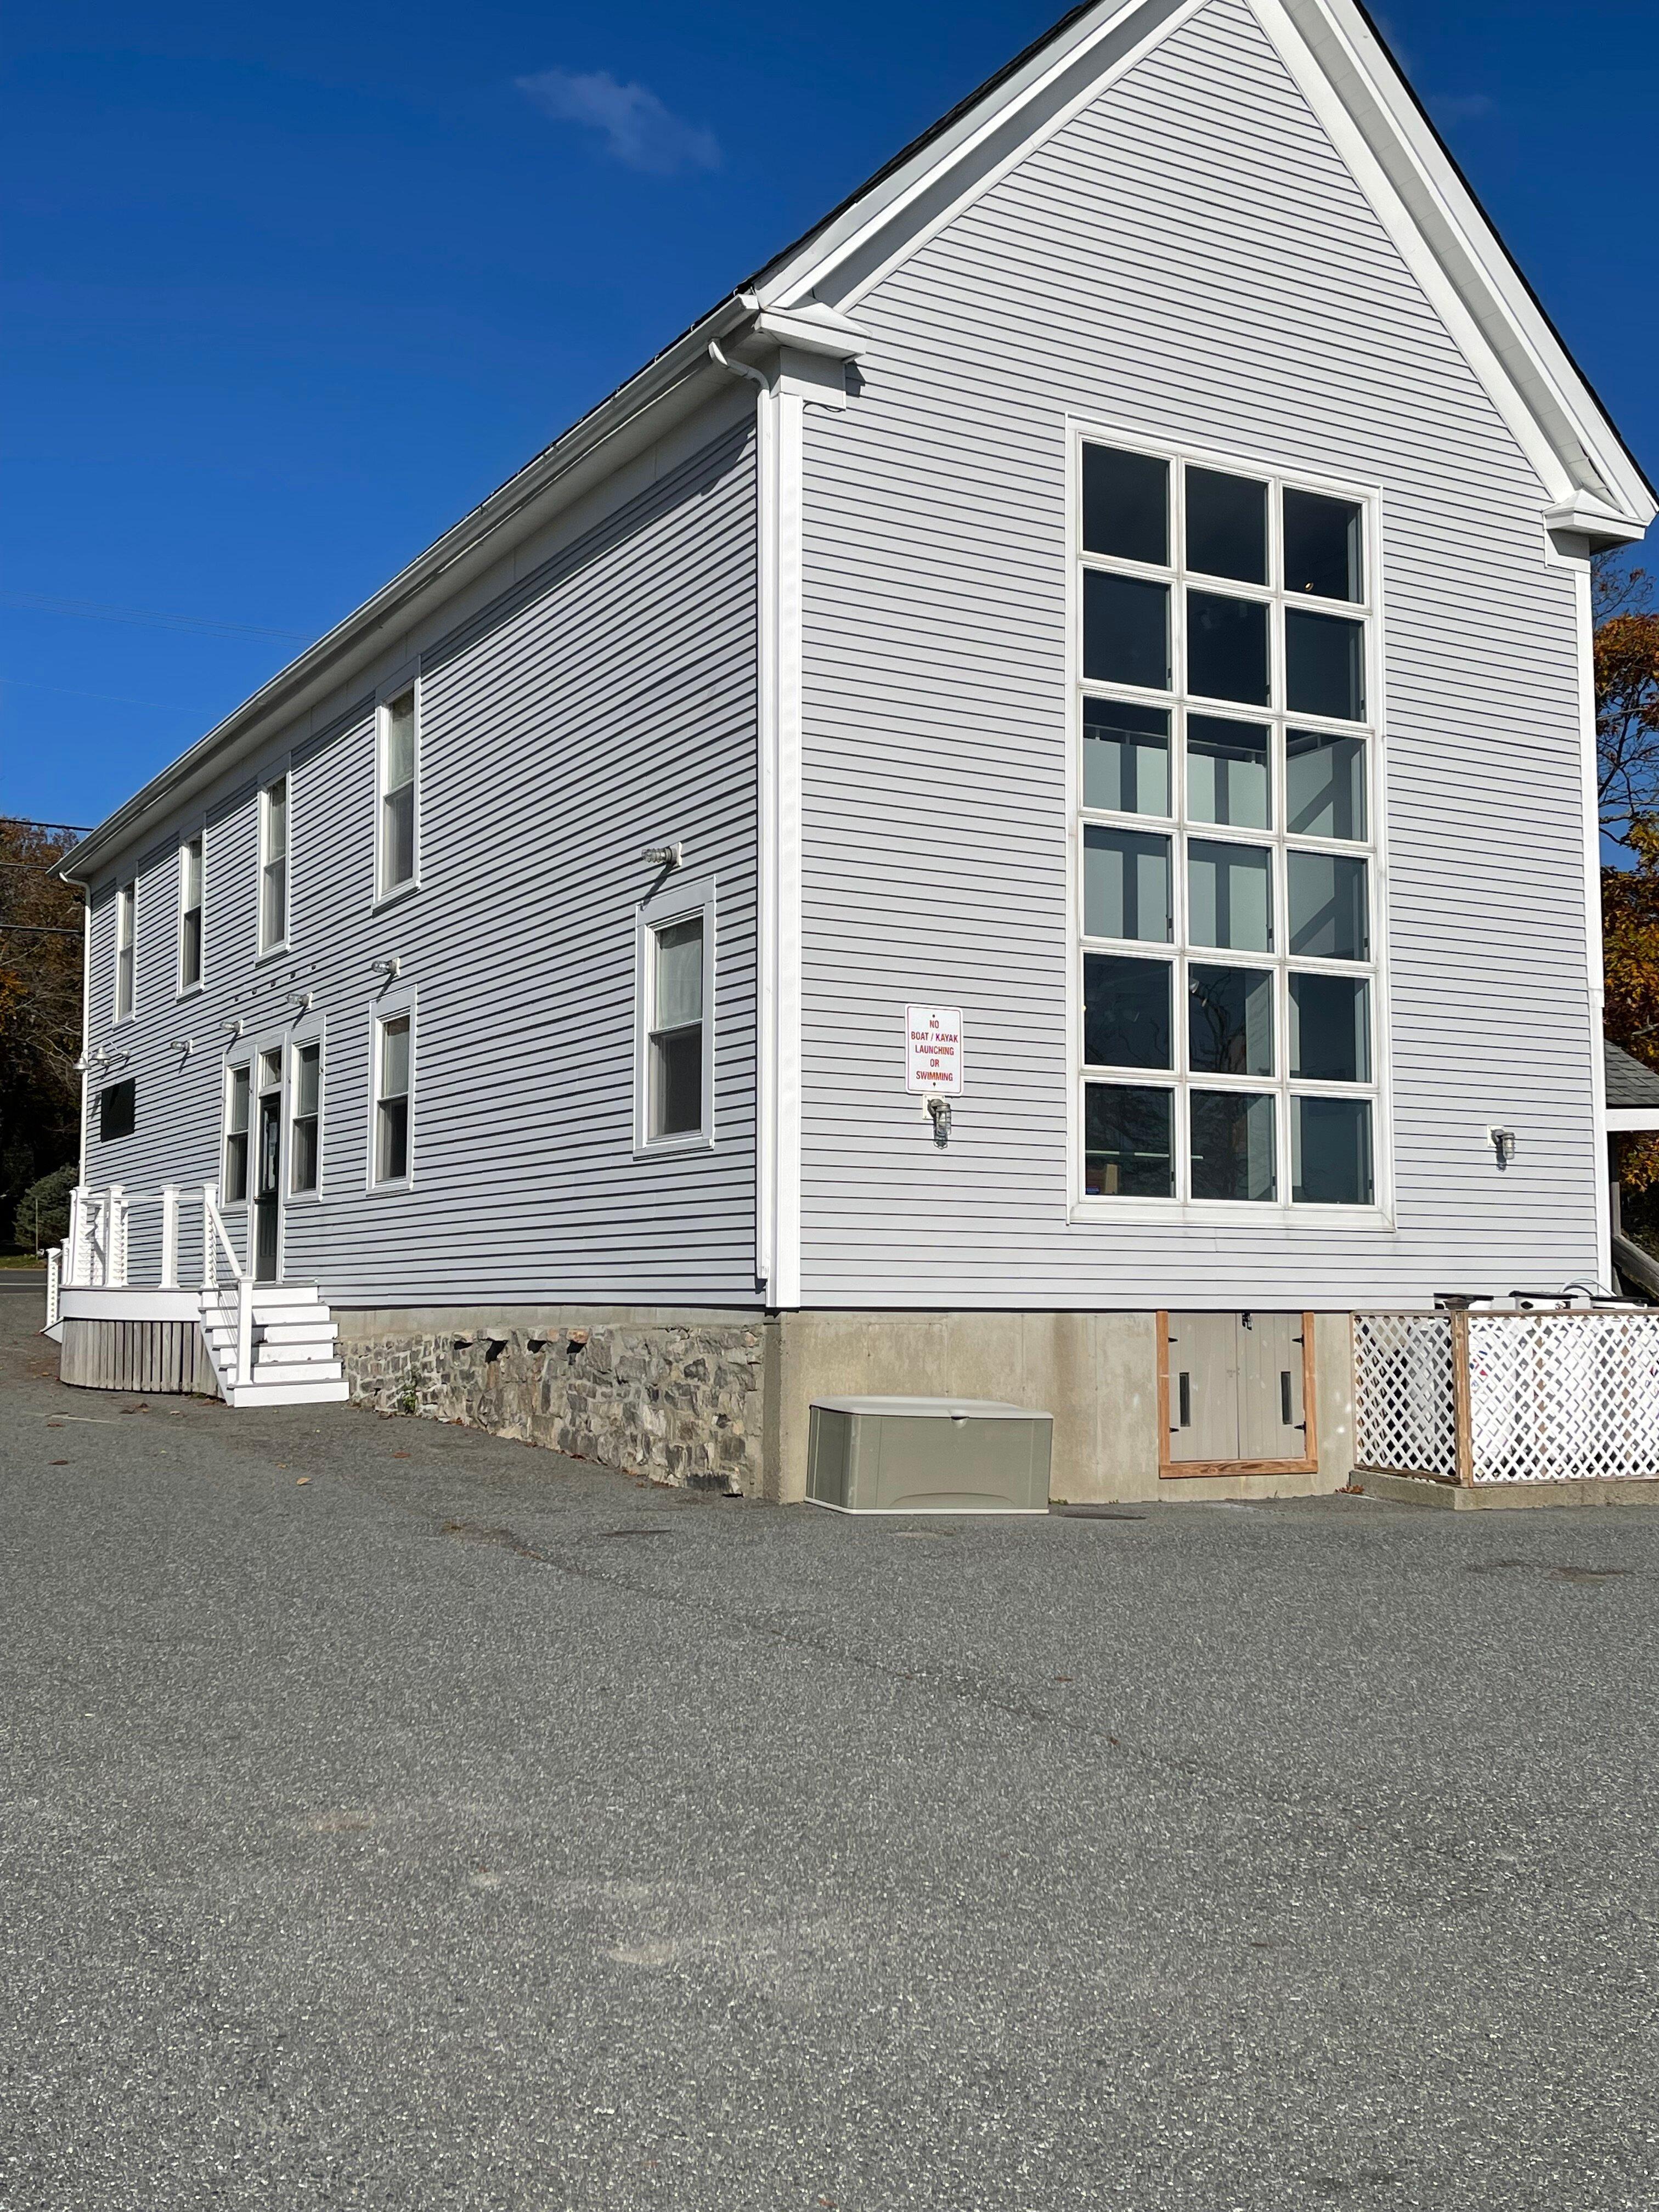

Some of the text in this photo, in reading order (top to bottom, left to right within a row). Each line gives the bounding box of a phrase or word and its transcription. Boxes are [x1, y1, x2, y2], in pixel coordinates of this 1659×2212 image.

[929, 1020, 939, 1029] NO
[911, 1031, 929, 1041] BOAT
[935, 1033, 958, 1043] KAYAK
[915, 1045, 955, 1056] LAUNCHING
[930, 1059, 940, 1068] OR
[916, 1071, 953, 1081] SWIMMING
